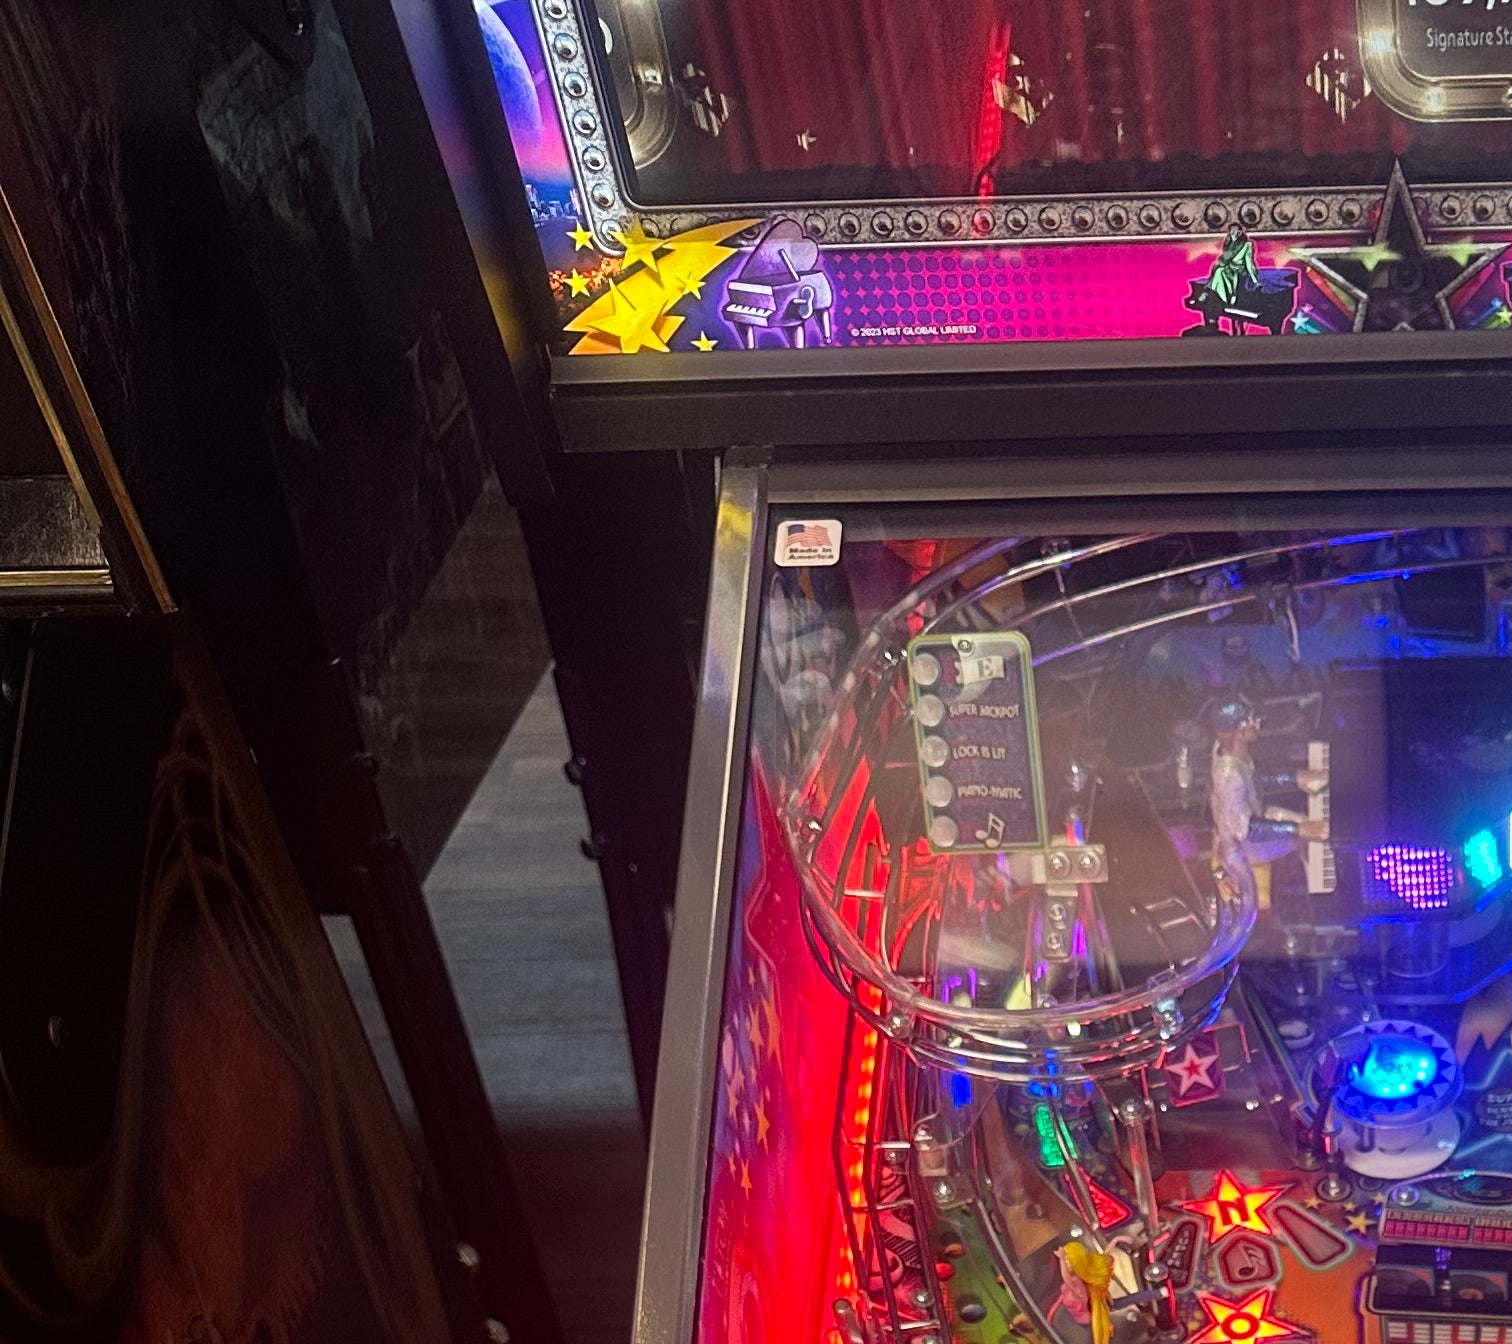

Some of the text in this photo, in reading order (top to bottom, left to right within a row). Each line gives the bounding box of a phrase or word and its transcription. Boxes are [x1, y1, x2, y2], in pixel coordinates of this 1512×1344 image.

[1427, 28, 1493, 52] Signature
[1217, 1197, 1251, 1227] N
[1221, 1312, 1261, 1340] O
